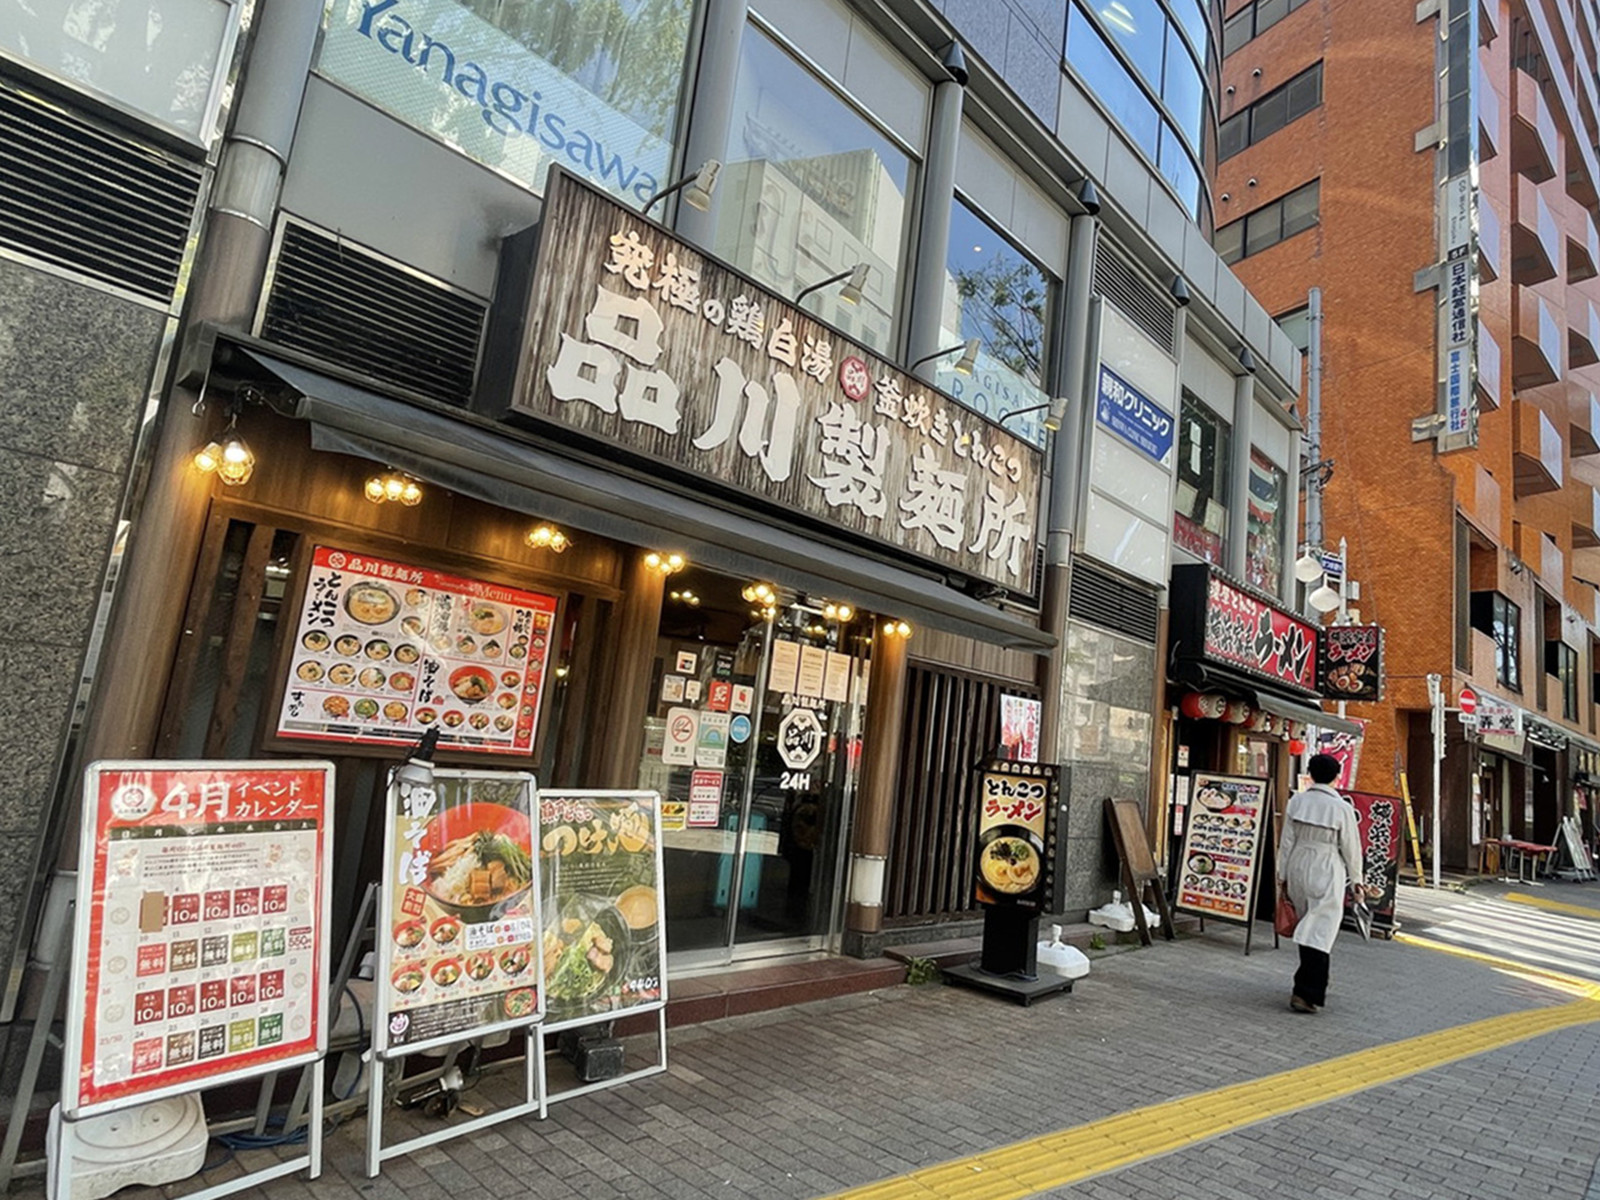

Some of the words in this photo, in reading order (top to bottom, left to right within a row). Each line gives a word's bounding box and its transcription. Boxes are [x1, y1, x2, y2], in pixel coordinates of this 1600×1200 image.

[356, 0, 660, 210] Yanagisawa
[603, 230, 834, 384] 究極の鶏白湯
[546, 284, 1030, 576] 品川製麺所
[307, 577, 327, 626] ラーメン
[320, 571, 342, 628] とんこつ
[475, 584, 513, 602] Menu
[1253, 608, 1312, 683] ラーメン
[418, 658, 440, 704] 油そば
[160, 780, 231, 819] 4月
[234, 780, 302, 798] イベント
[779, 771, 811, 791] 24H
[985, 778, 1047, 800] とんこつ
[234, 797, 319, 818] カレンダー
[542, 801, 650, 857] つけ麺
[984, 799, 1043, 823] ラーメン
[398, 782, 438, 887] 油そば
[1365, 799, 1395, 888] 横浜家系
